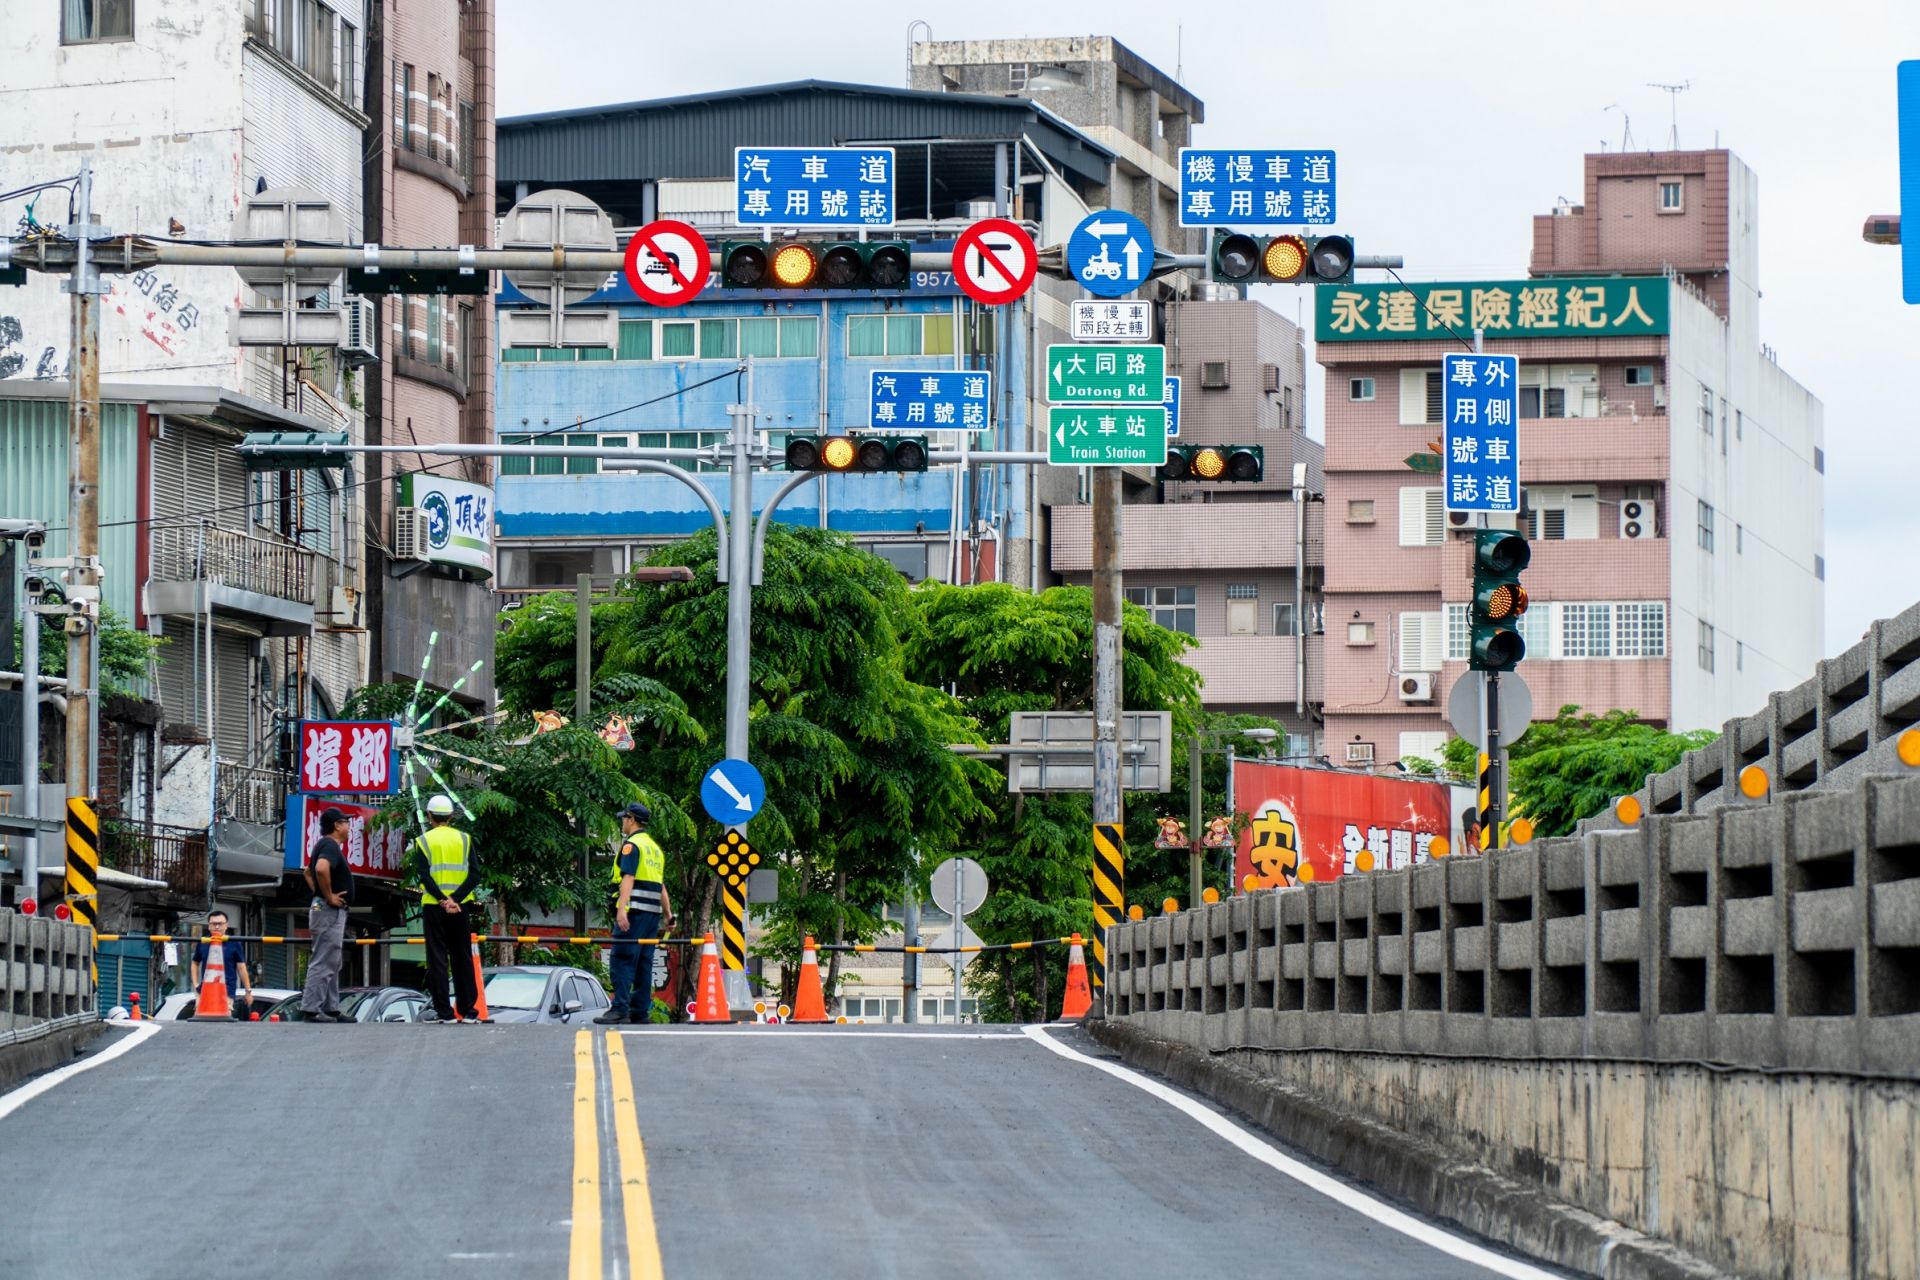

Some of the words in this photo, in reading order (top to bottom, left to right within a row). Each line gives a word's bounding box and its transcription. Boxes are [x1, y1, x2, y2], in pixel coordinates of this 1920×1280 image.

[743, 154, 888, 184] 汽車道
[1186, 155, 1331, 184] 機慢車道
[743, 188, 887, 218] 專用號誌
[1186, 189, 1331, 218] 專用號誌
[1079, 305, 1143, 320] 機慢車
[1329, 286, 1655, 334] 永達保險經紀人
[1080, 321, 1144, 335] 兩段左轉
[1066, 353, 1147, 376] 大同路
[876, 376, 985, 398] 汽車道
[1066, 385, 1122, 399] Datong
[1128, 383, 1149, 397] Rd.
[876, 401, 984, 424] 專用號誌
[1070, 414, 1147, 437] 火車站
[1450, 358, 1479, 503] 專用號誌
[1483, 360, 1511, 503] 外側車道
[1069, 445, 1099, 459] Train
[1105, 445, 1146, 459] Station
[304, 727, 388, 789] 檳榔
